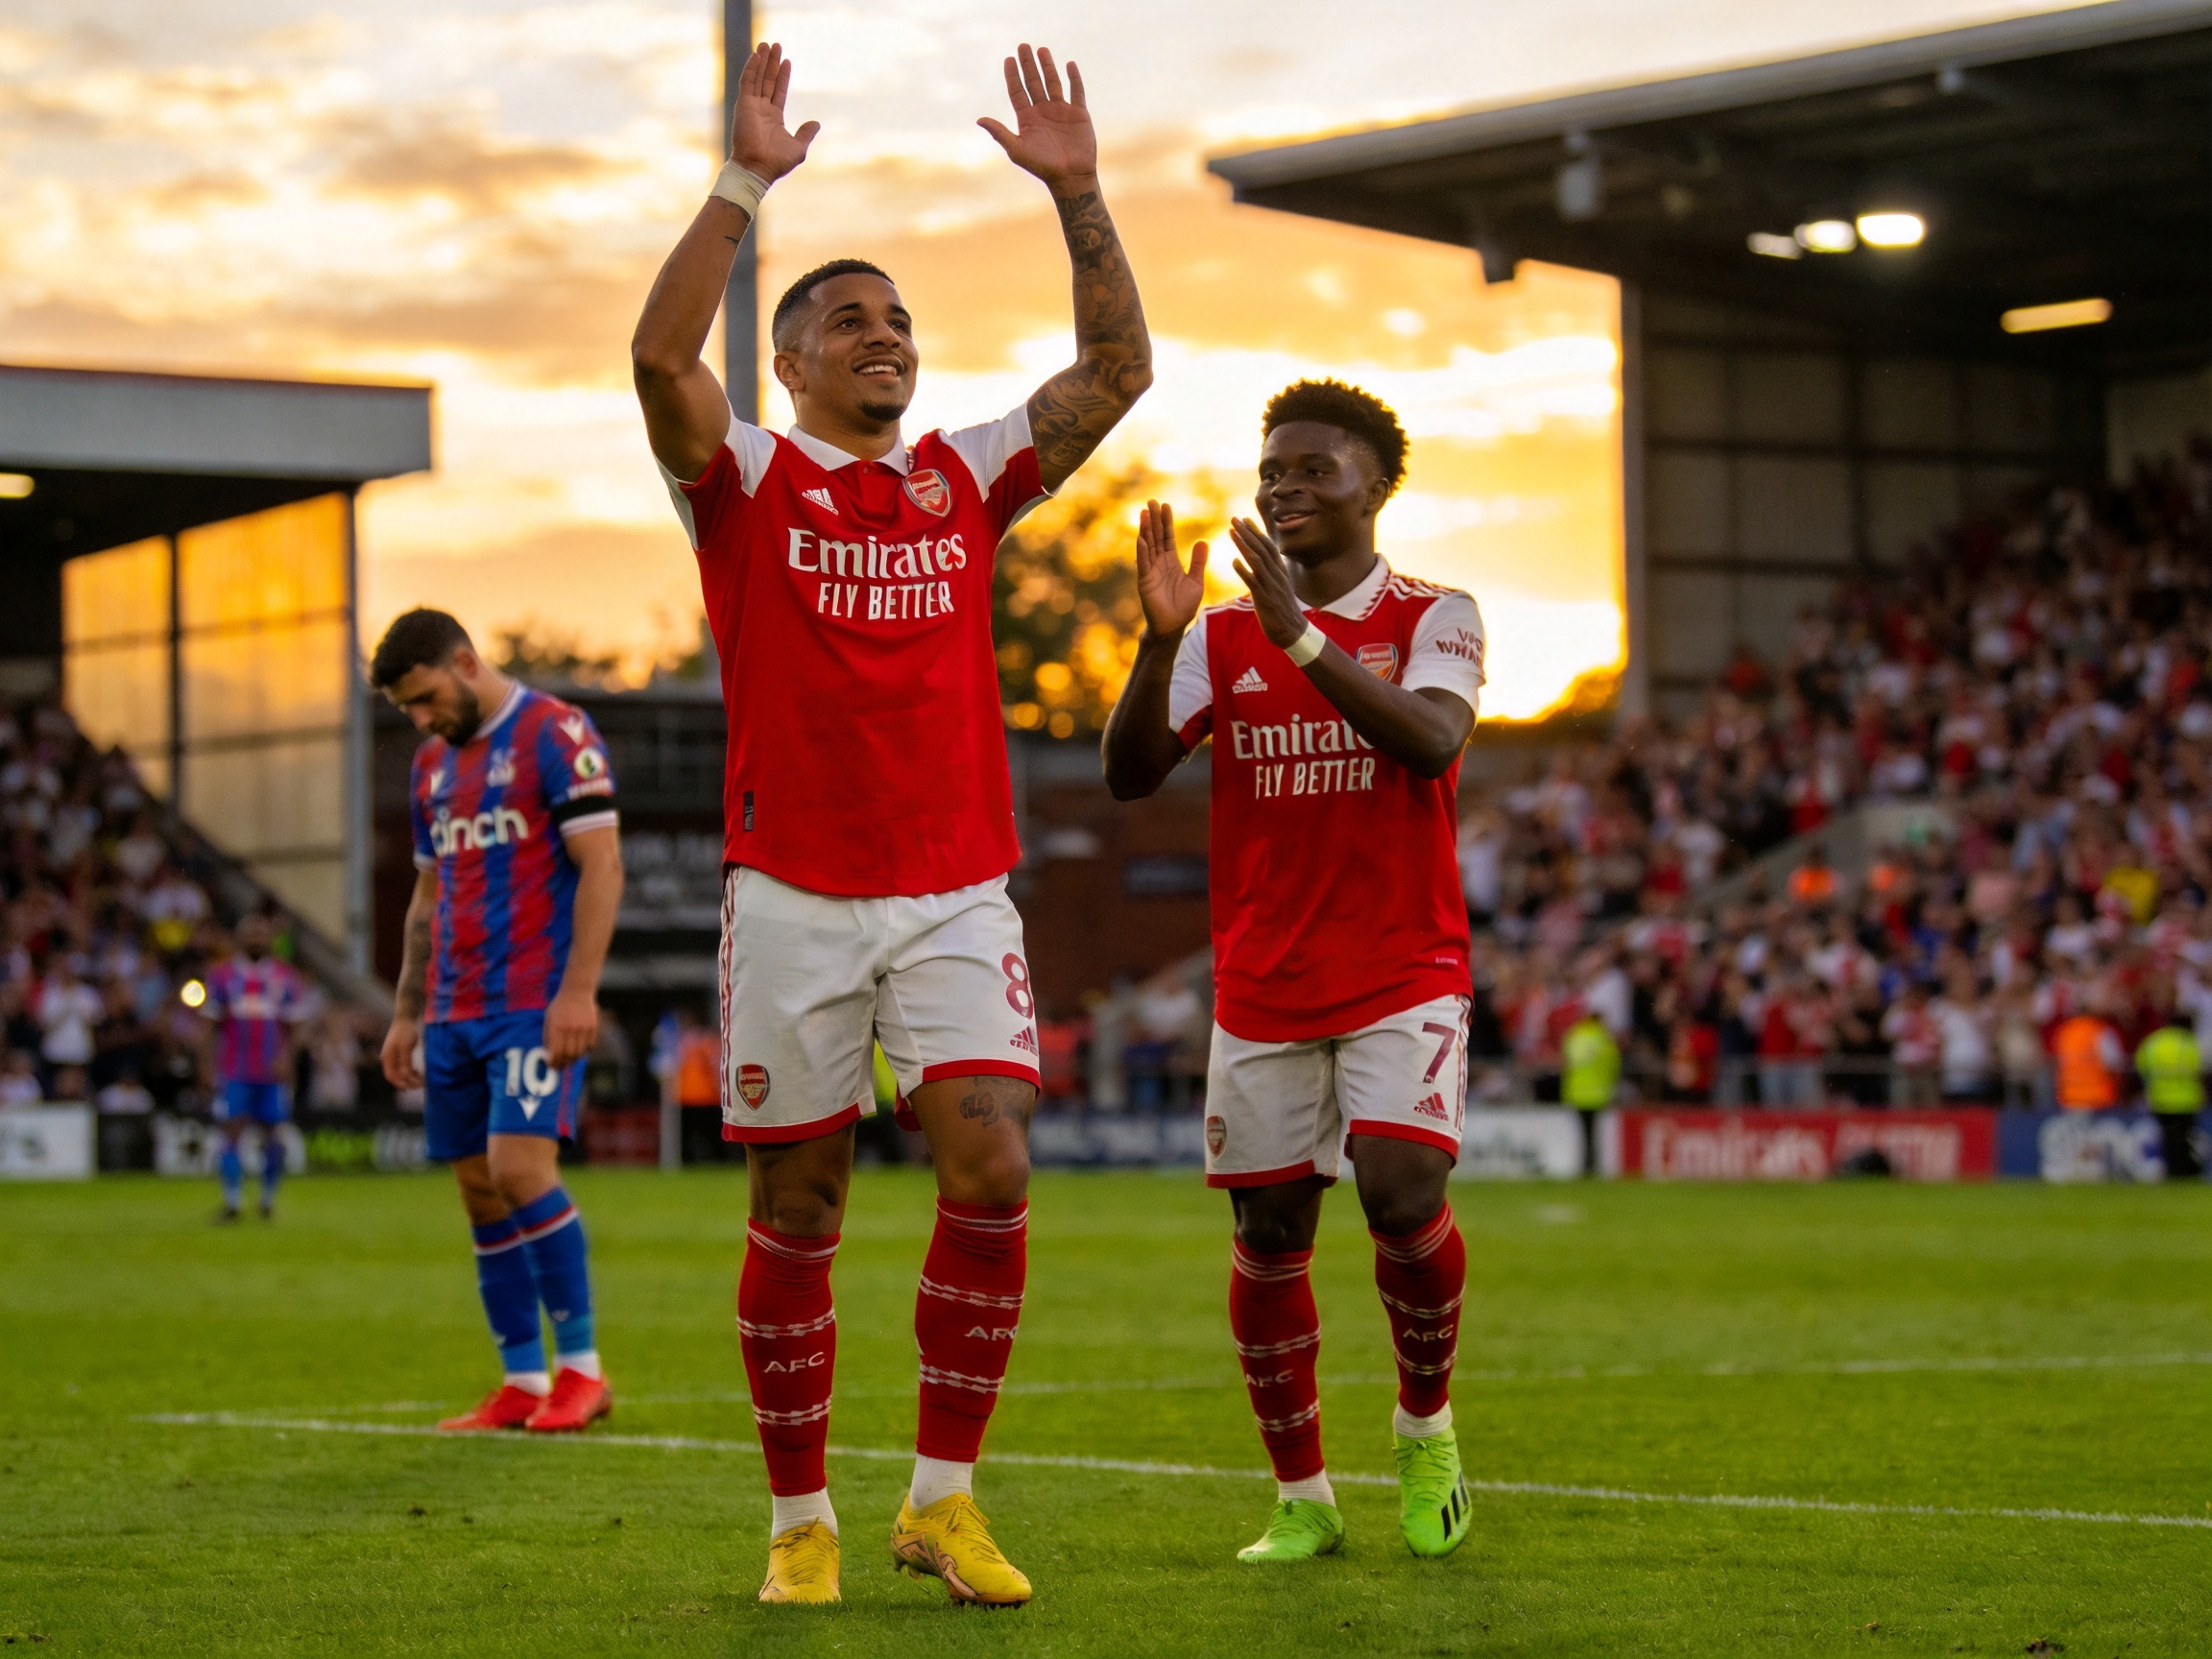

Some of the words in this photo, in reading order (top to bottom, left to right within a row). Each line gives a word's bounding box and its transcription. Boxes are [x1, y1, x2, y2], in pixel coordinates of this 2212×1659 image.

[787, 526, 967, 578] Emirates
[817, 582, 858, 618] FLY
[868, 581, 955, 620] BETTER
[1230, 713, 1376, 759] Emirat
[1255, 763, 1284, 800] FLY
[1292, 757, 1376, 797] BETTER
[1001, 951, 1034, 1020] 8
[504, 1046, 560, 1096] 10
[1422, 1021, 1456, 1085] 7
[1402, 1323, 1454, 1342] AFC
[763, 1351, 826, 1373] AFC
